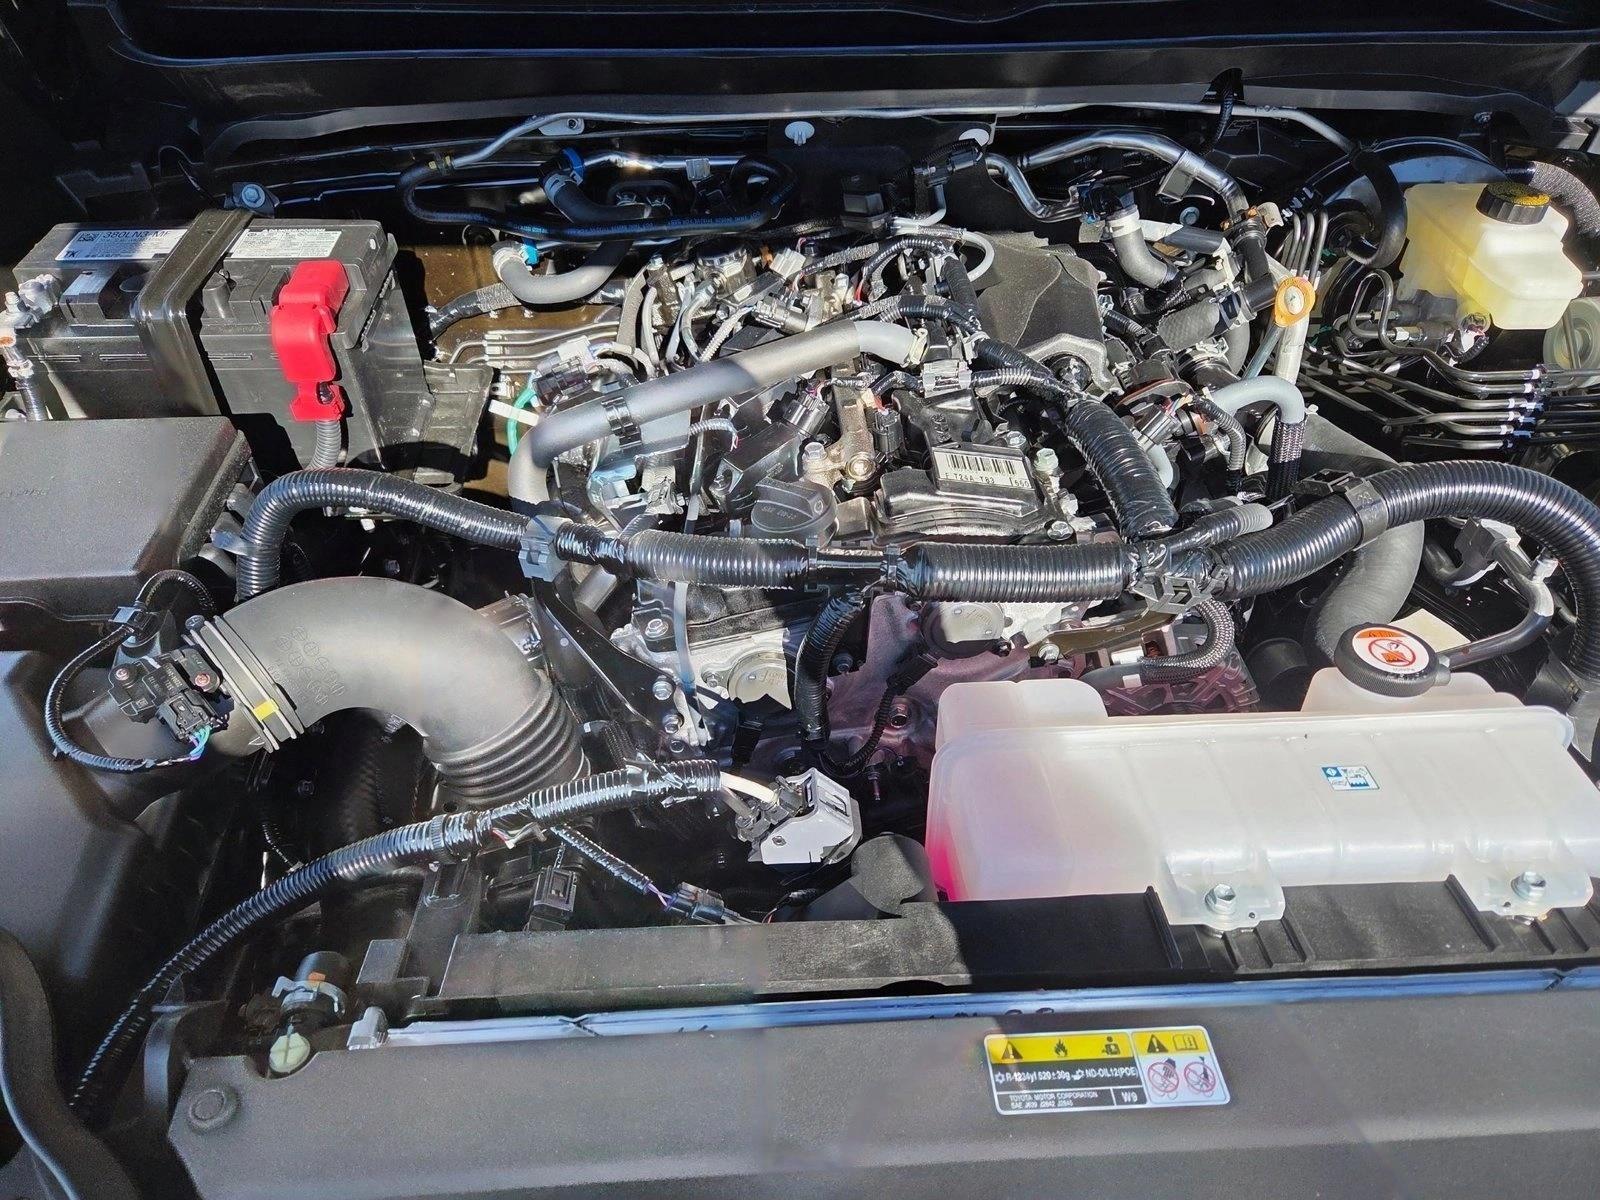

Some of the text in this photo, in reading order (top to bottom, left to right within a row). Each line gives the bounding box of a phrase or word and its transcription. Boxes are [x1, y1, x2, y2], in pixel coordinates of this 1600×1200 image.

[1009, 1091, 1098, 1102] TOYOTA MOTOR CORPORATION
[1121, 1091, 1139, 1103] W9
